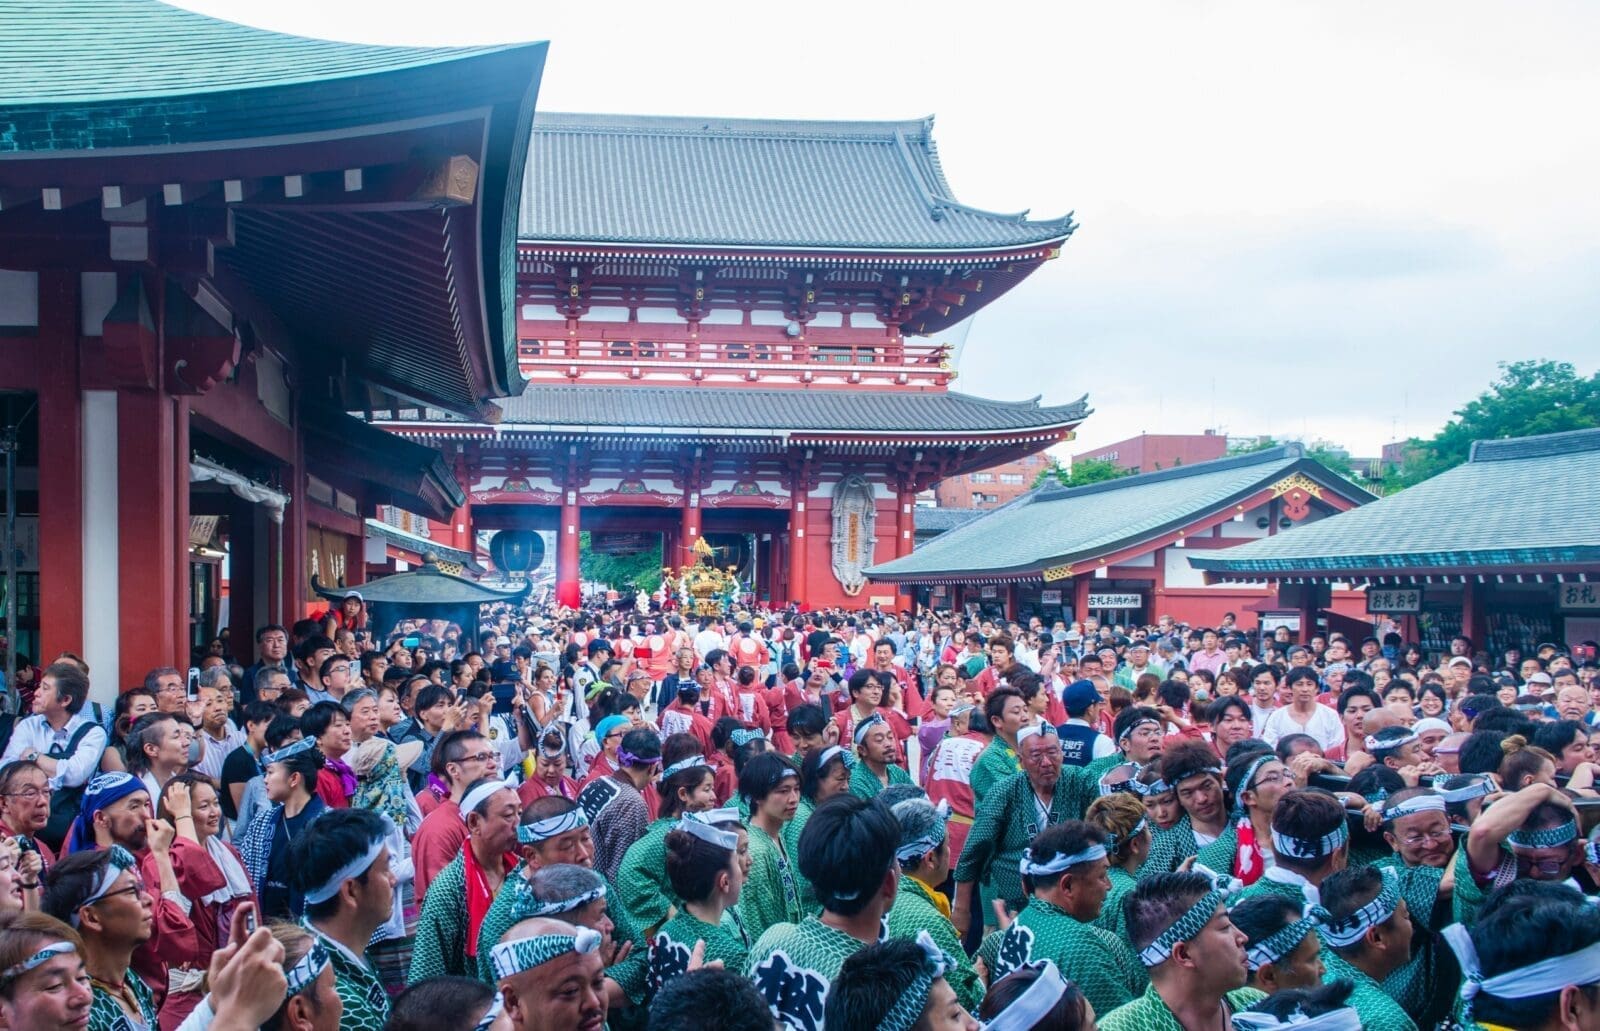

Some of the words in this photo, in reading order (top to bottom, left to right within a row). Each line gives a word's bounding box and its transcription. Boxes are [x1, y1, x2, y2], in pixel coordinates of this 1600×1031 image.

[1088, 595, 1139, 606] 古札お納め所
[1373, 591, 1417, 609] お札お守
